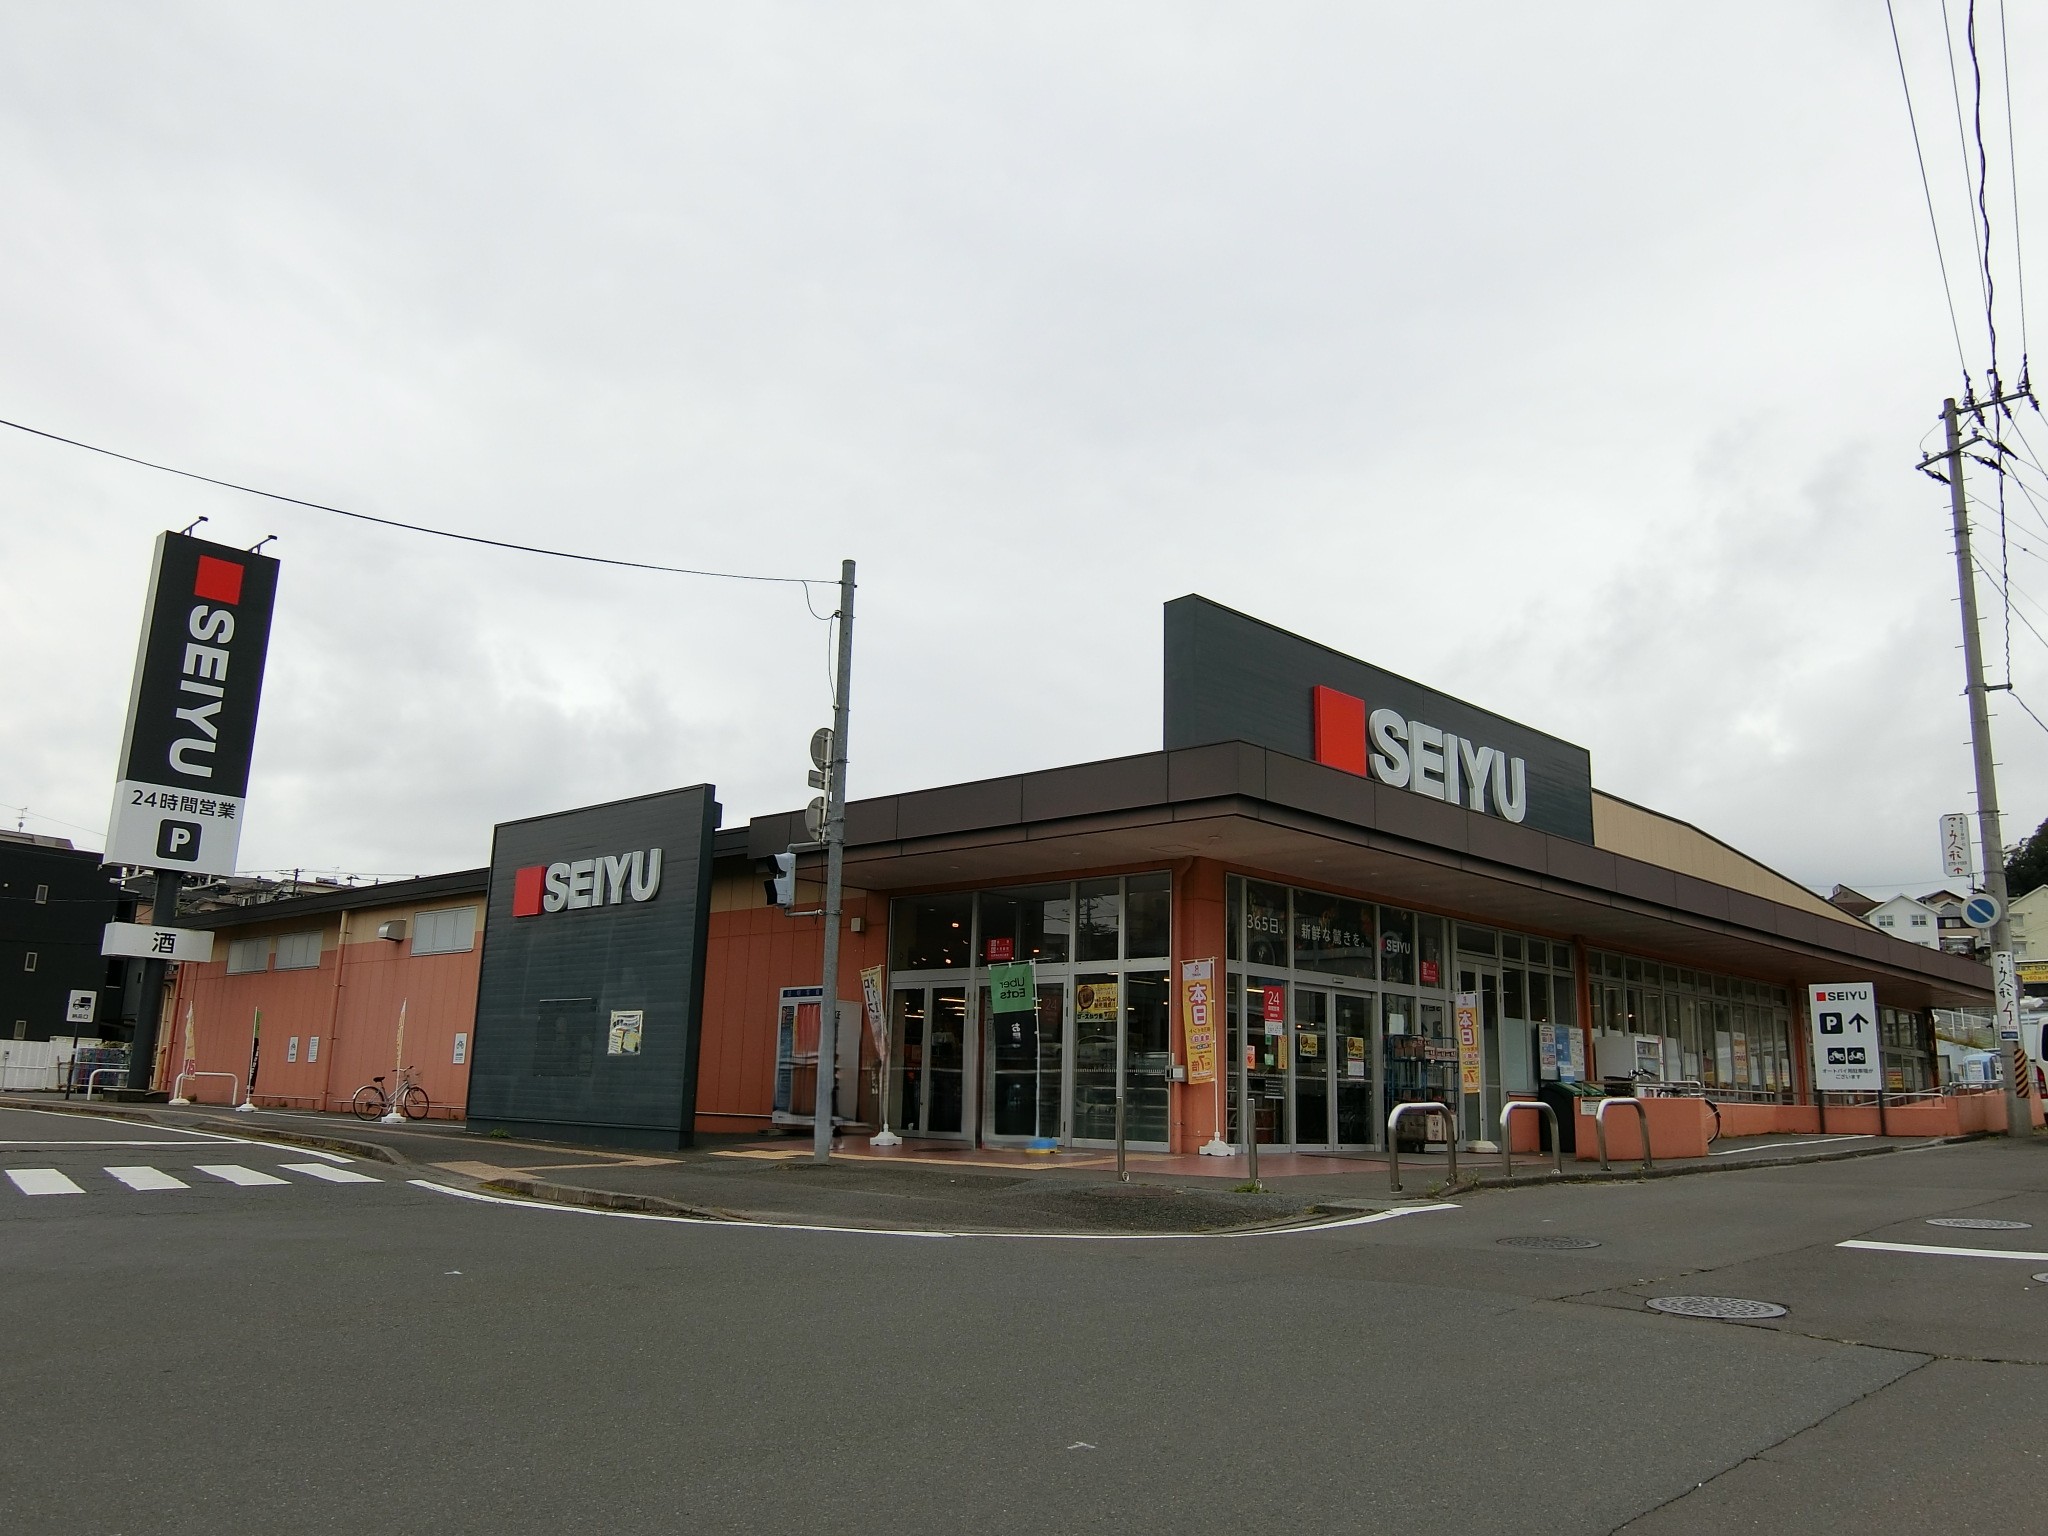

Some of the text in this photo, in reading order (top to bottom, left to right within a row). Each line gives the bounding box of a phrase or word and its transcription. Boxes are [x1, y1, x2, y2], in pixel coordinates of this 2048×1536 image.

[169, 604, 235, 778] SEIYU
[1369, 708, 1527, 823] SEIYU
[131, 789, 236, 820] 24時間営業
[169, 827, 191, 853] P
[542, 848, 662, 912] SEIYU
[151, 931, 177, 954] 酒
[1301, 923, 1365, 948] 新鮮な驚きを。
[1386, 939, 1411, 955] SEIYU
[1268, 990, 1280, 1005] 24
[1827, 991, 1867, 1001] SEIYU
[1826, 1016, 1837, 1030] P
